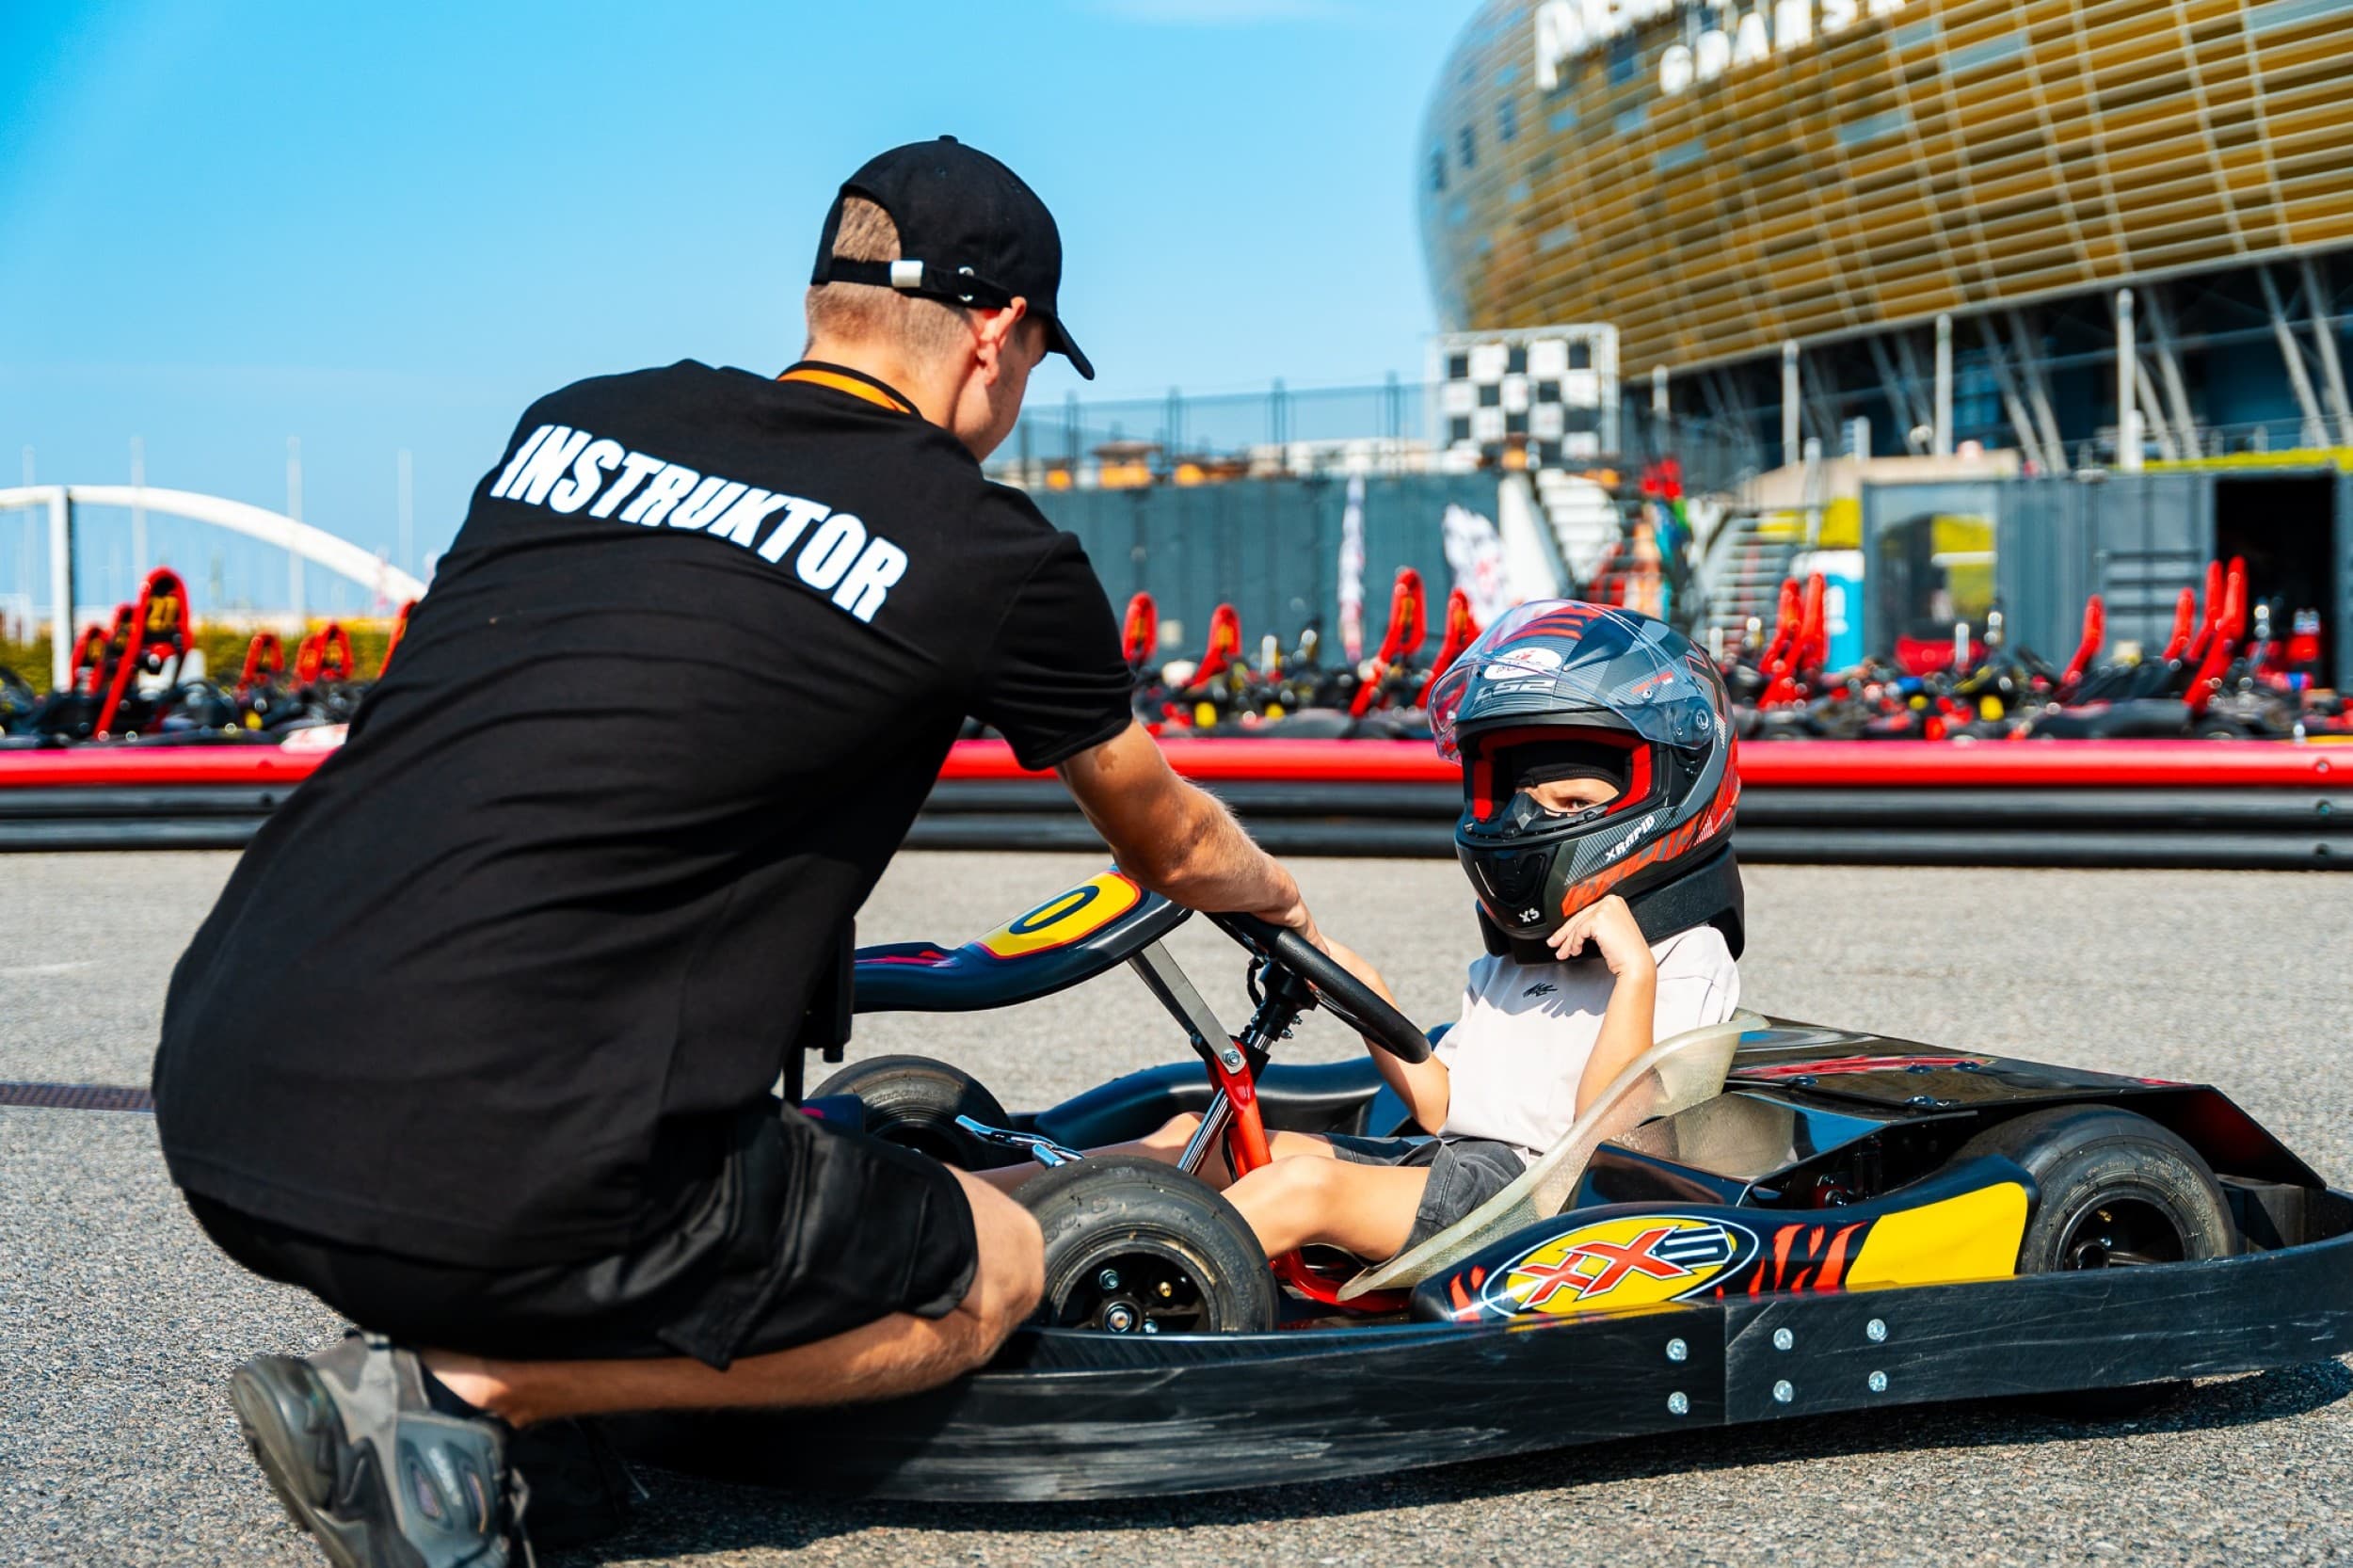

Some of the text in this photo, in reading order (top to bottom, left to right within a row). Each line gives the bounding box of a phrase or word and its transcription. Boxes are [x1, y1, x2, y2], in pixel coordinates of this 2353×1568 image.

[489, 424, 908, 624] INSTRUKTOR
[1605, 815, 1656, 863] XRAPID
[1008, 885, 1100, 935] 0
